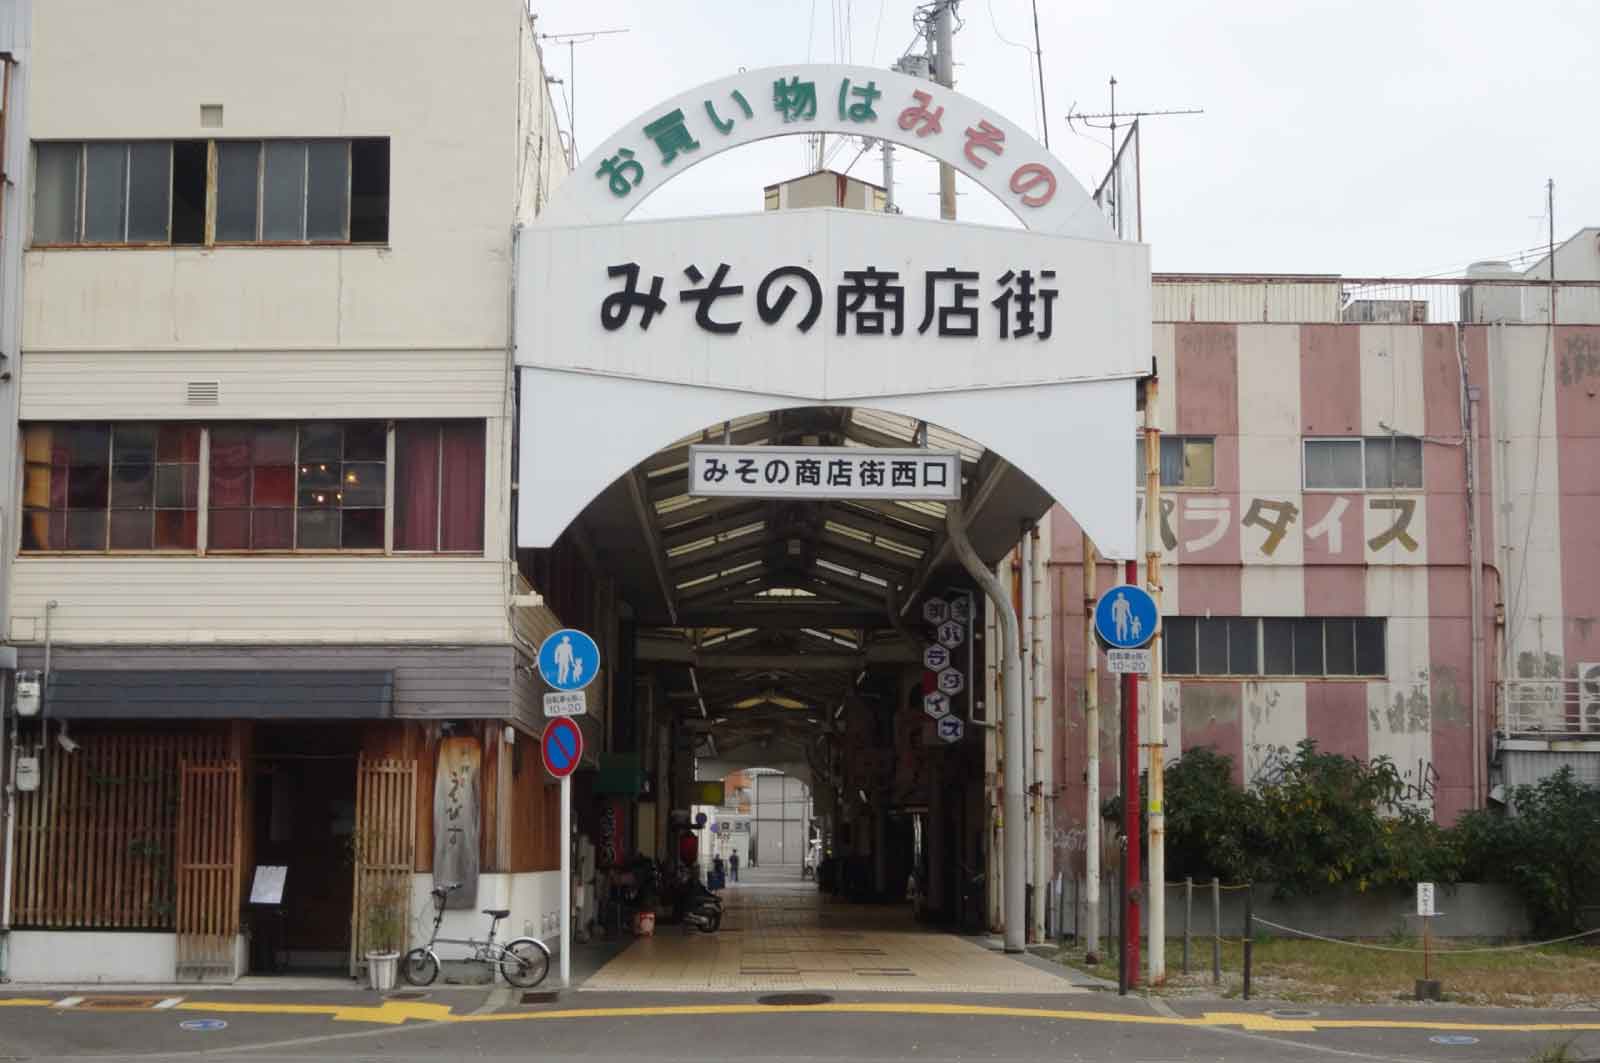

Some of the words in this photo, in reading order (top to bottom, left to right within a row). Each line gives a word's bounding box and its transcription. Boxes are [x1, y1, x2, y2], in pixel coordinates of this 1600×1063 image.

[595, 75, 1057, 208] お買い物はみその
[600, 261, 1059, 341] みその商店街
[702, 457, 948, 488] みその商店街西口
